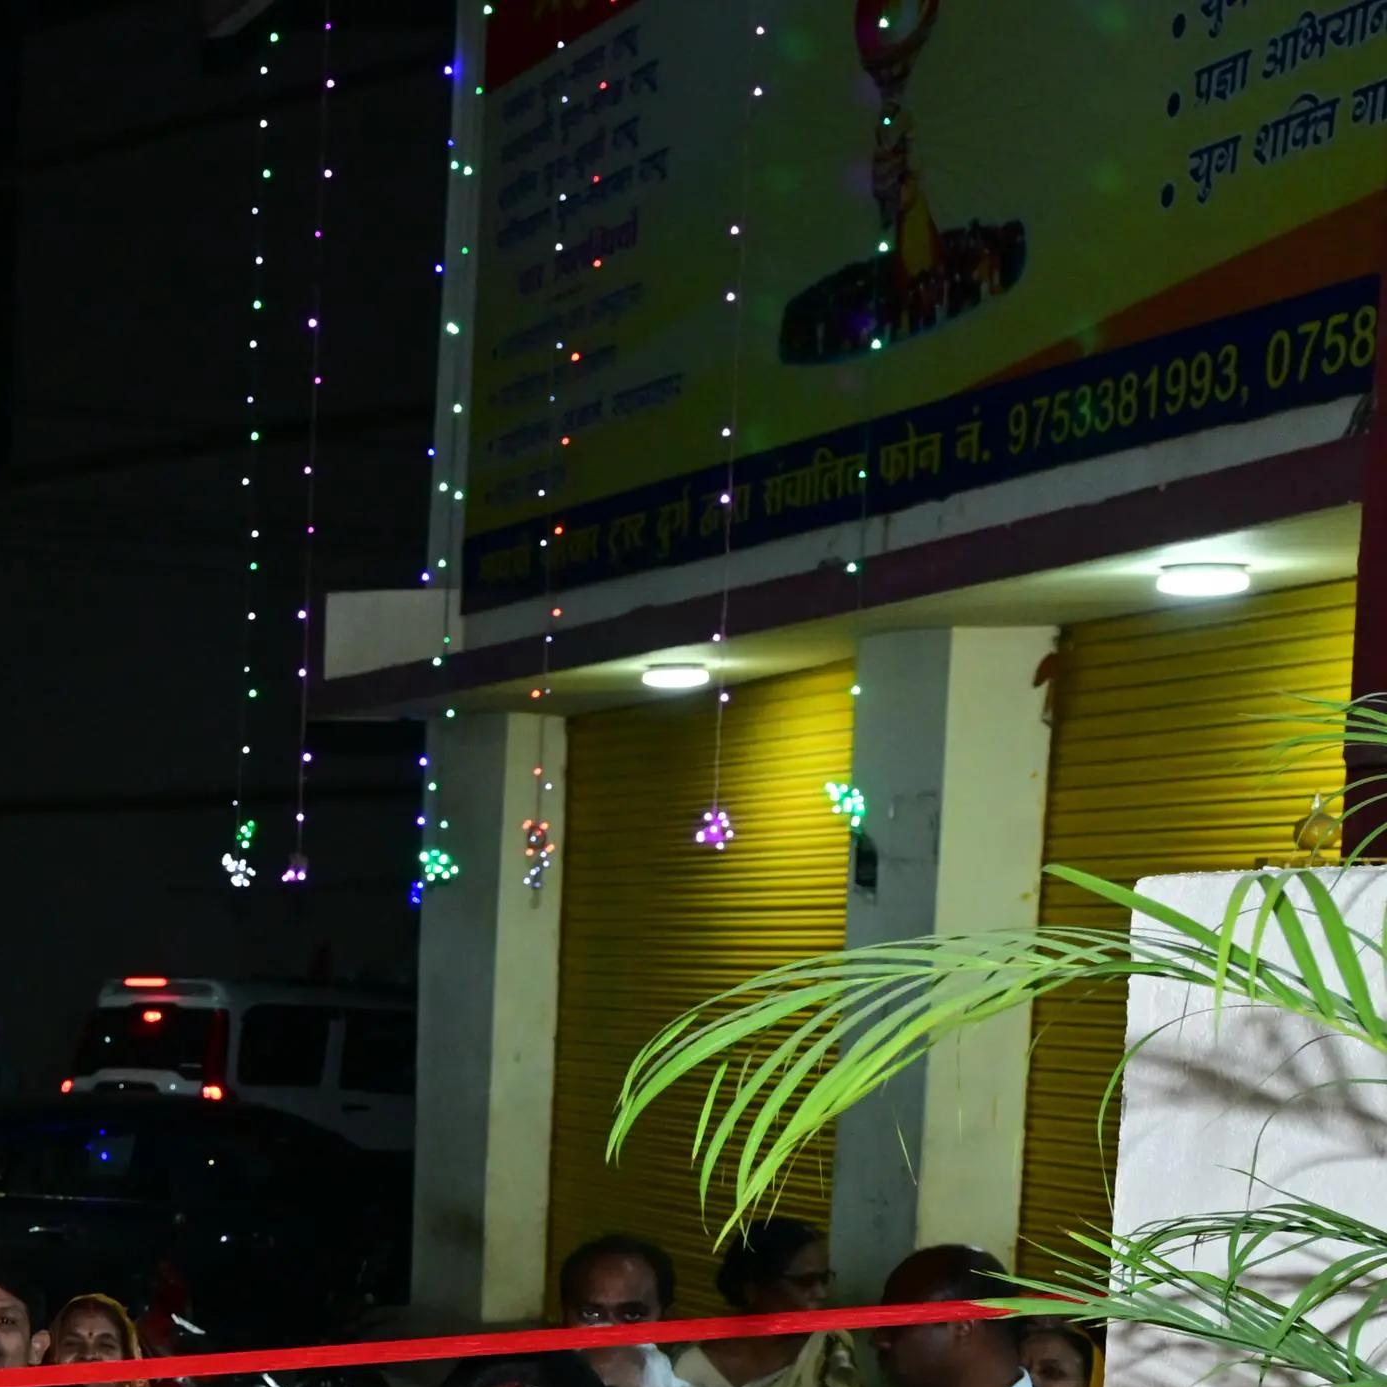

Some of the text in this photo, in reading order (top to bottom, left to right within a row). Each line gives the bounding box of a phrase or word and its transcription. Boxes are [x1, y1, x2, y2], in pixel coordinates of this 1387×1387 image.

[1189, 135, 1241, 203] युग
[1254, 94, 1340, 164] शक्ति
[656, 482, 692, 558] दुर्ग
[762, 447, 868, 516] संचालित
[879, 421, 943, 486] फोन
[954, 405, 992, 466] नं.
[1007, 343, 1250, 456] 9753381993,
[1265, 304, 1378, 390] 0758
